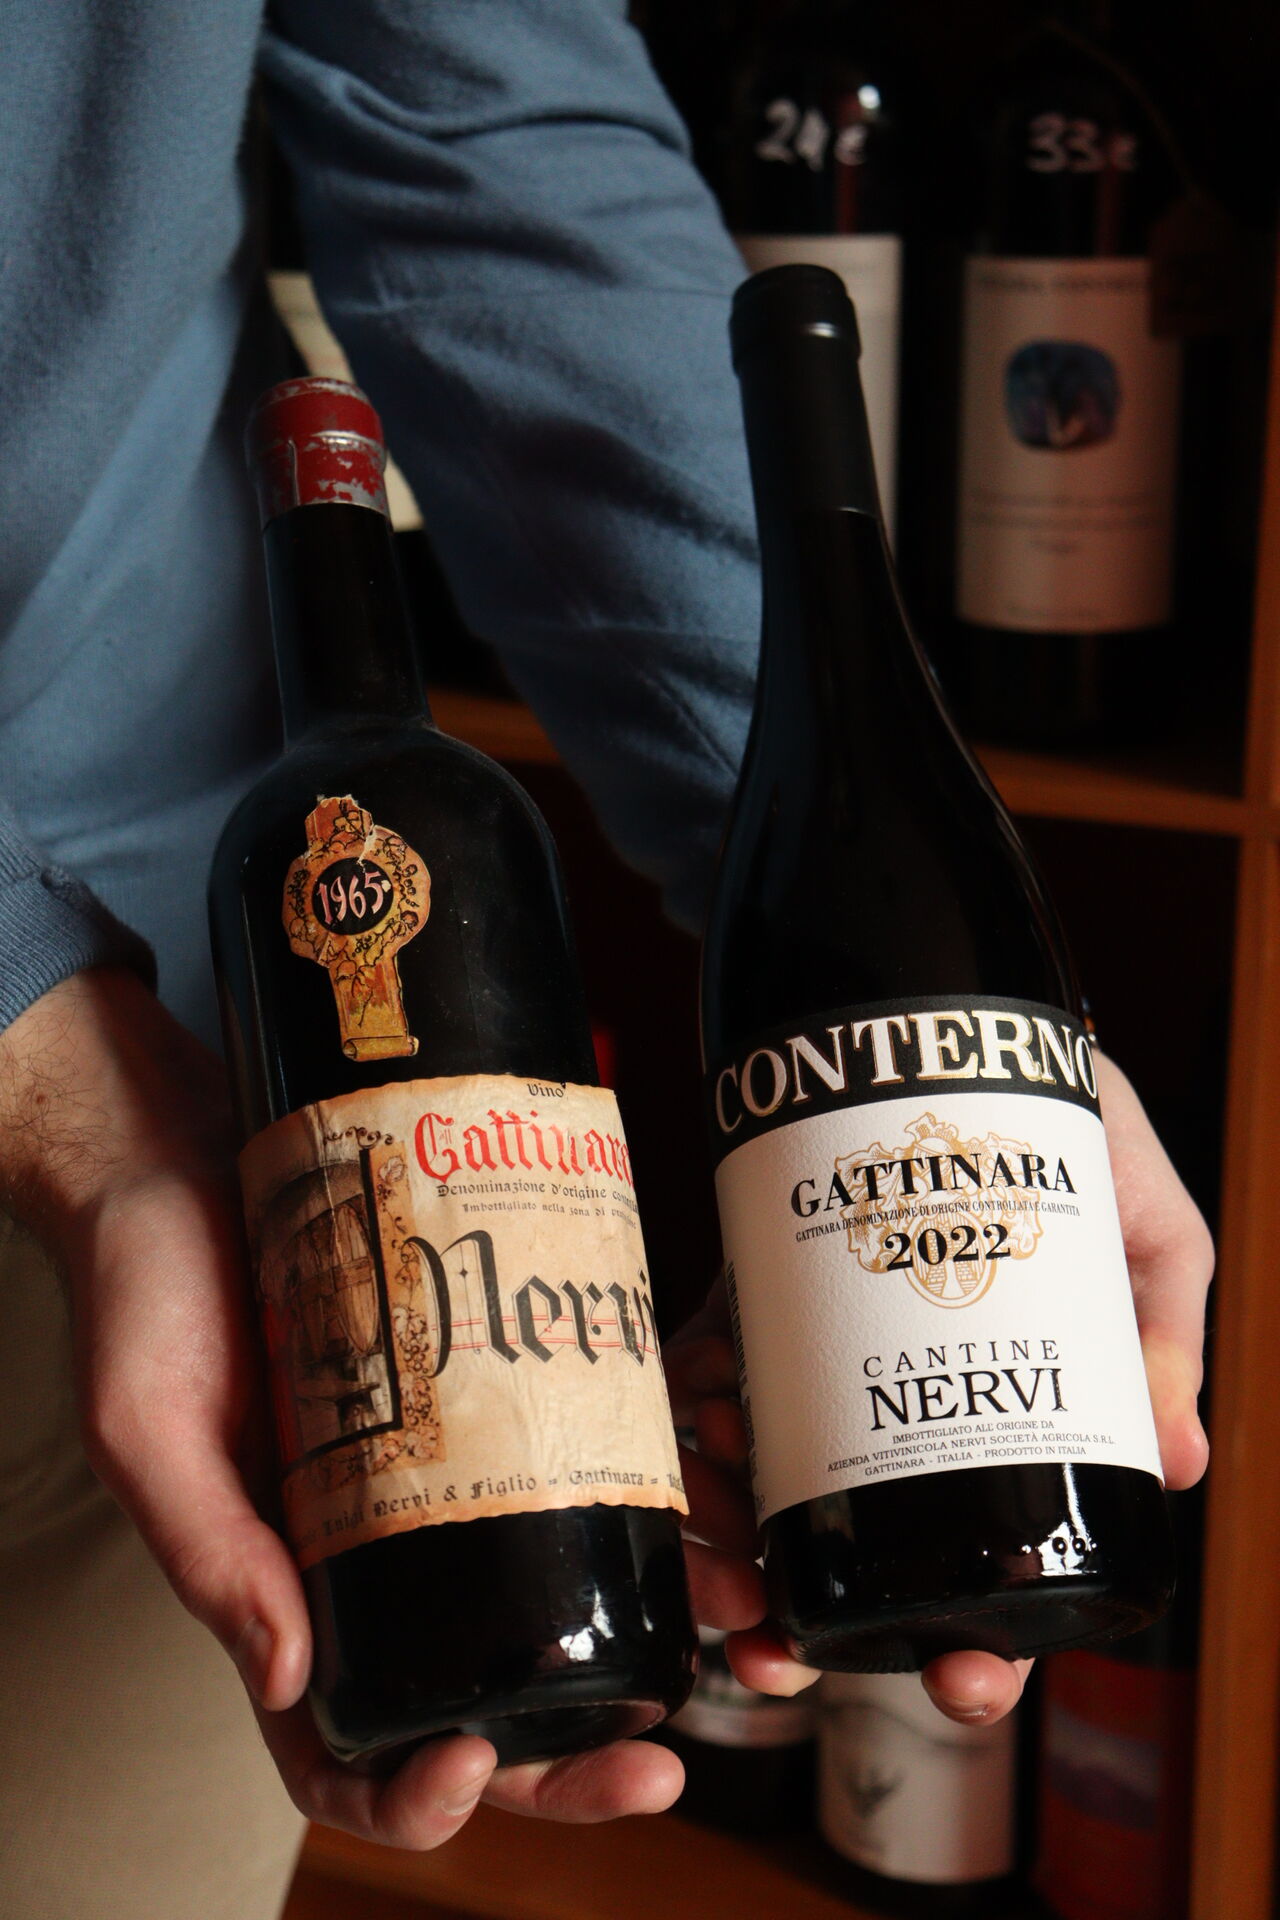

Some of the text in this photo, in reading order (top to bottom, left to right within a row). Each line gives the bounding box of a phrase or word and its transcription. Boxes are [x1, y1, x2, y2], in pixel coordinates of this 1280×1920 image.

[317, 871, 384, 925] 1965
[527, 1083, 564, 1098] Vino
[715, 1010, 1098, 1134] CONTERNO
[437, 1180, 545, 1197] Denominazione
[790, 1152, 1077, 1218] GATTINARA
[796, 1200, 1080, 1243] GATTINARA DENOMINAZIONE DI ORIGINE CONTROLLATA E GARANTITA
[885, 1223, 1011, 1271] 2022
[863, 1339, 1059, 1378] CANTINE
[865, 1367, 1068, 1431] NERVI
[827, 1454, 870, 1473] AZIENDA
[871, 1440, 948, 1461] VITIVINICOLA
[951, 1436, 986, 1448] NERVI
[989, 1432, 1038, 1445] SOCIETÀ
[1040, 1433, 1091, 1442] AGRICOLA
[892, 1425, 972, 1444] IMBOTTIGLIATO
[996, 1420, 1038, 1431] ORIGINE
[1040, 1420, 1054, 1429] DA
[864, 1457, 925, 1476] GATTINARA
[937, 1451, 973, 1464] ITALIA
[984, 1446, 1042, 1459] PRODOTTO
[1046, 1446, 1056, 1455] IN
[1058, 1446, 1086, 1455] ITALIA
[443, 1485, 457, 1502] &
[470, 1474, 536, 1499] Figlio
[569, 1468, 643, 1486] Gattinara
